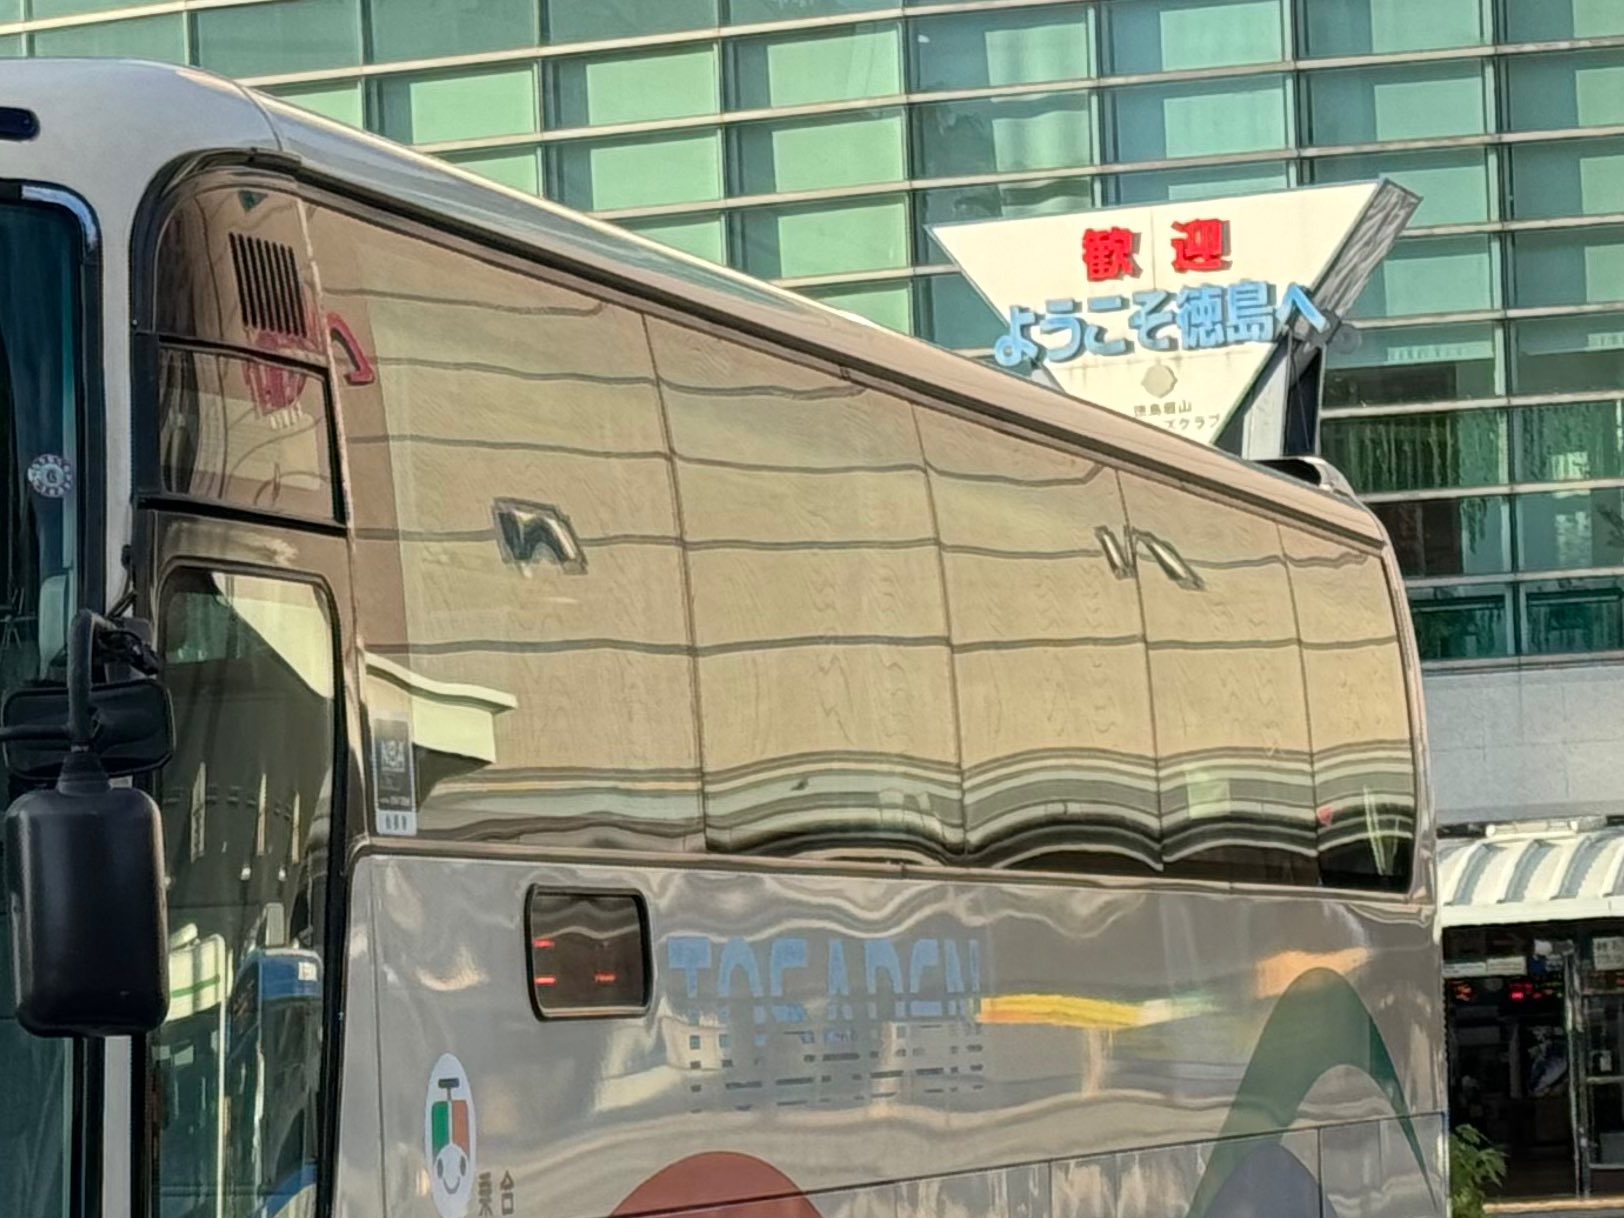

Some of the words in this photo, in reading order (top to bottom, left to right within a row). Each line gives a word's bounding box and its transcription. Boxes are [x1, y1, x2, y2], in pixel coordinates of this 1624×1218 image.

[1081, 219, 1226, 283] 歓迎
[993, 279, 1327, 367] ようこそ徳島へ
